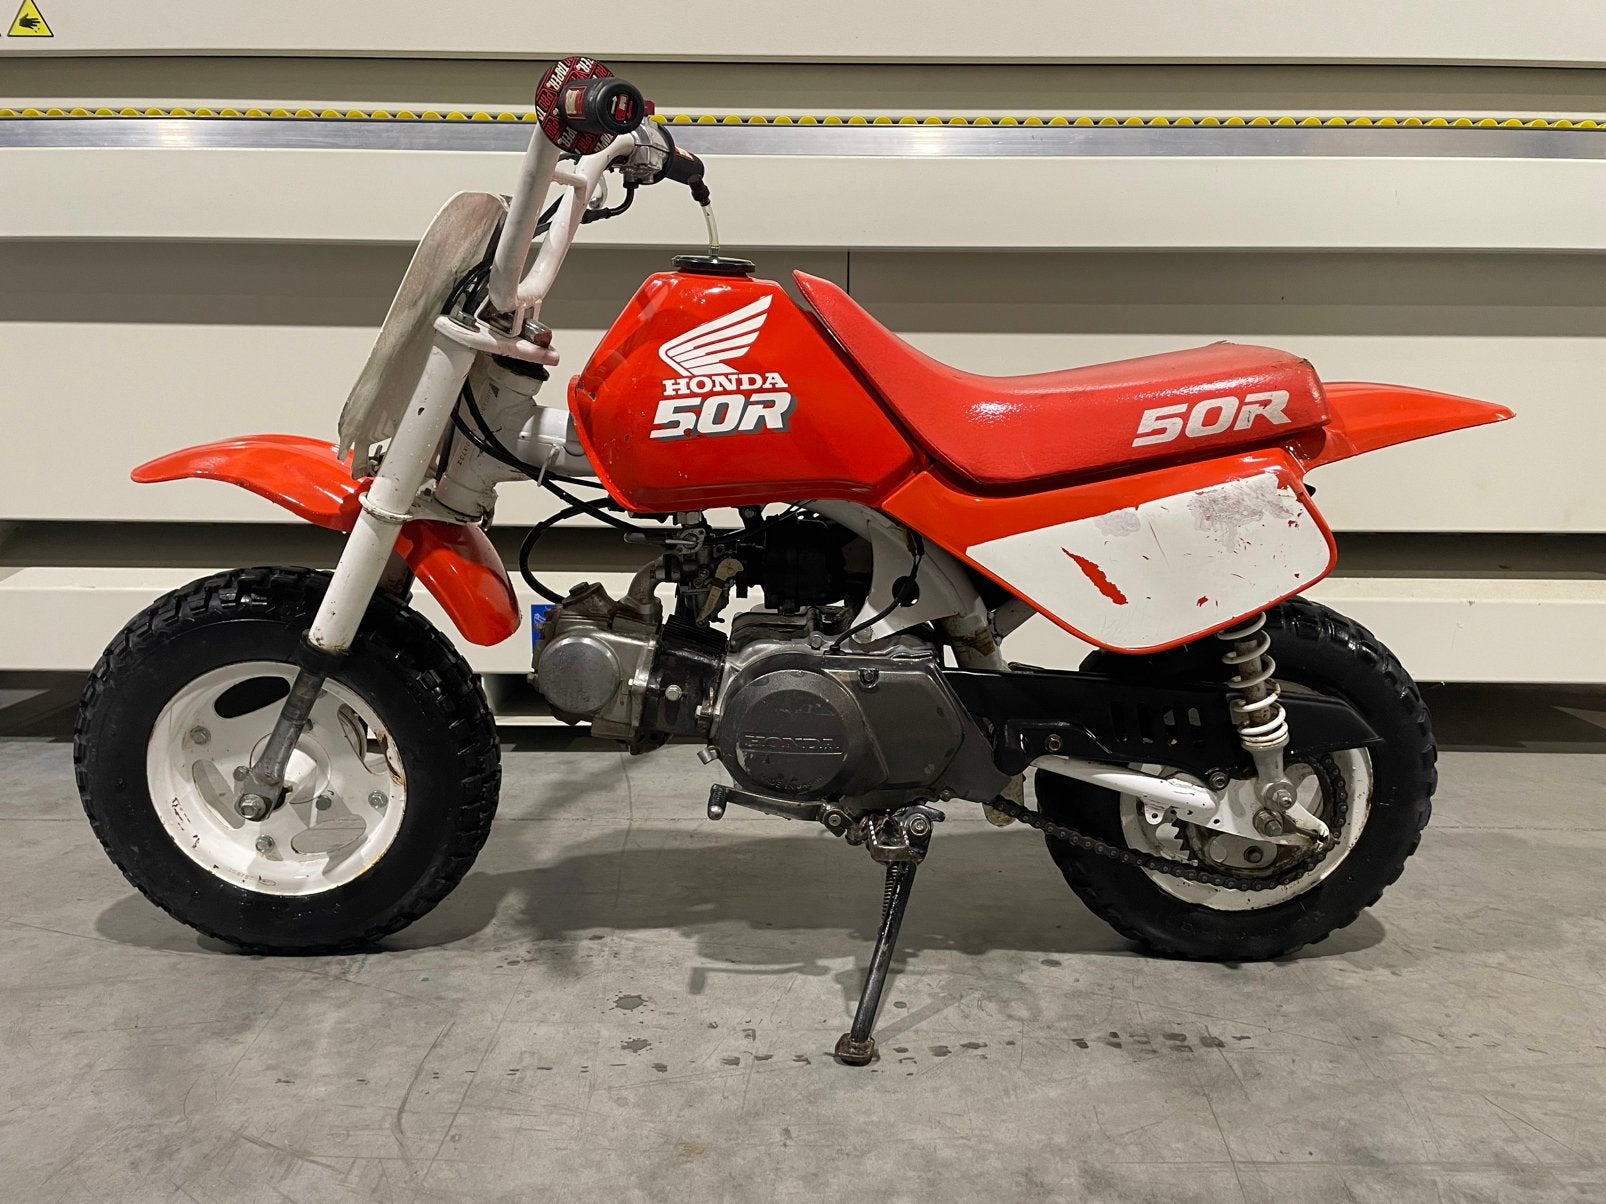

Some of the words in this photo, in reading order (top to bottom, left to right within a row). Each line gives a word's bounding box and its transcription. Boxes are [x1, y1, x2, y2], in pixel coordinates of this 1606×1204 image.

[662, 372, 789, 396] HONDA
[649, 391, 794, 440] 50R
[1131, 389, 1292, 448] 50R
